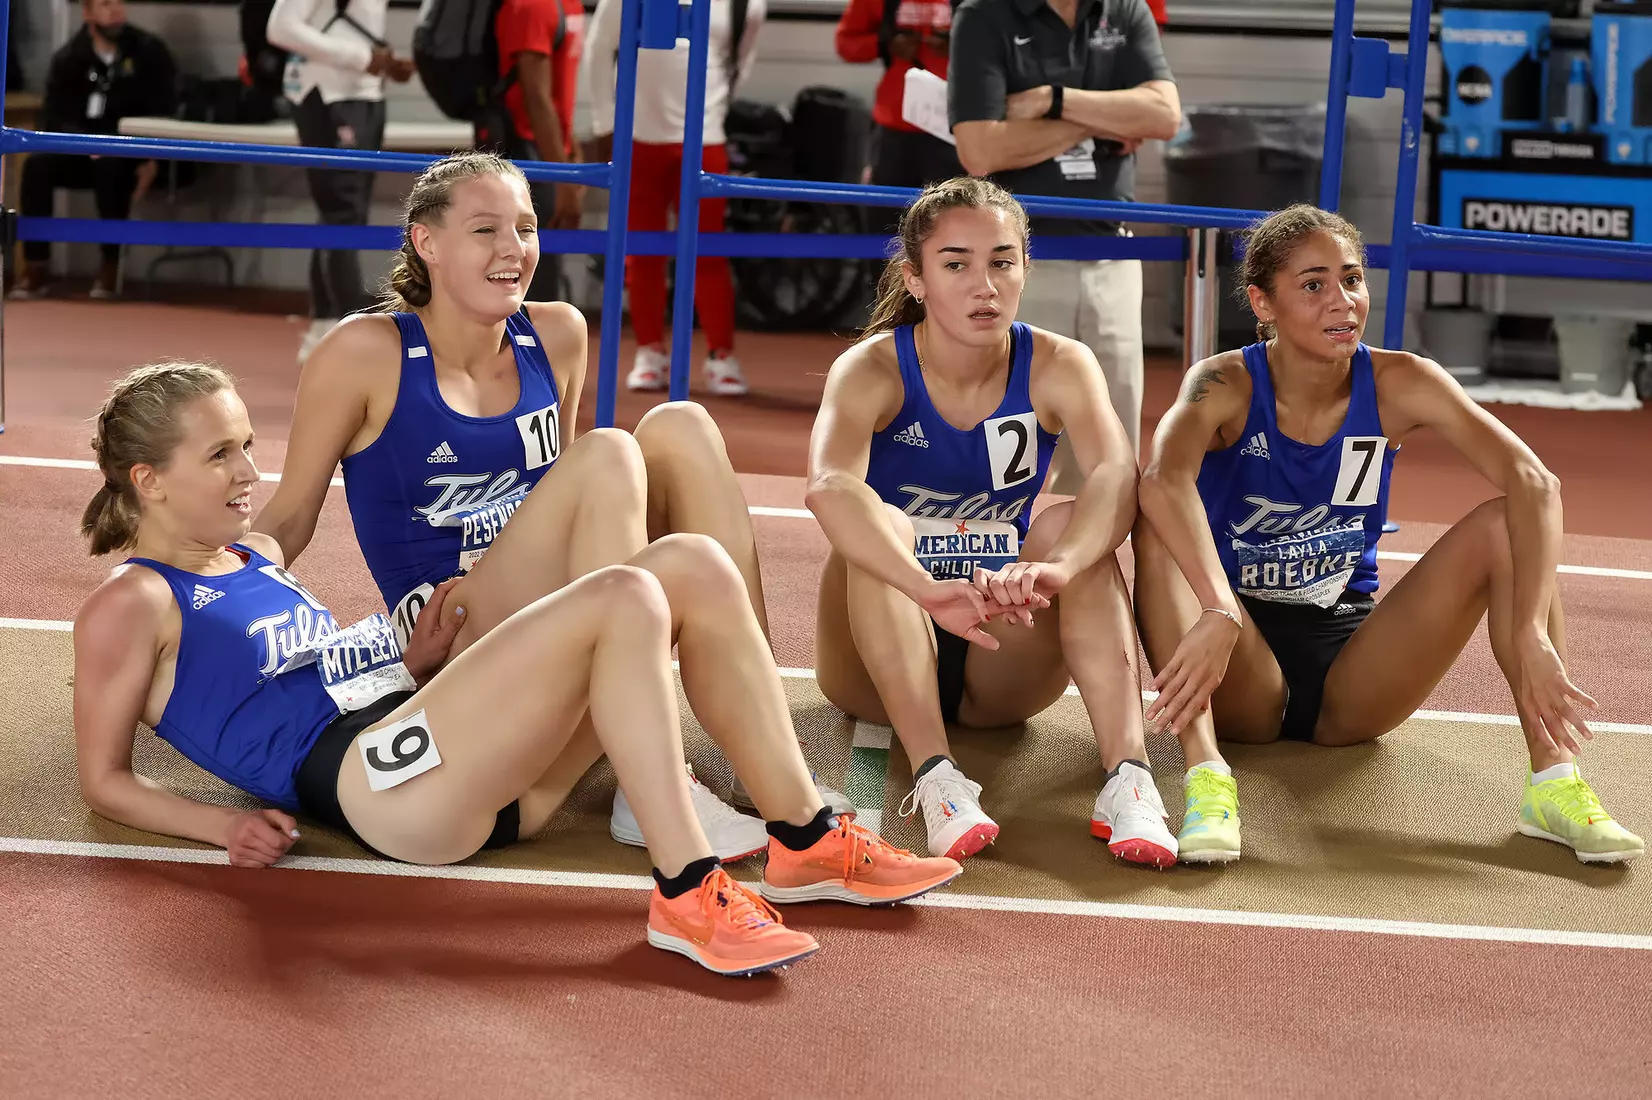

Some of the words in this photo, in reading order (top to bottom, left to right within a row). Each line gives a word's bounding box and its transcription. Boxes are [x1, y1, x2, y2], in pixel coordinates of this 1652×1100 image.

[1464, 202, 1631, 237] POWERADE
[529, 409, 558, 463] 10
[894, 433, 929, 449] adidas
[998, 420, 1030, 484] 2
[1240, 443, 1271, 460] adidas
[426, 454, 458, 464] adidas
[1346, 441, 1377, 502] 7
[414, 468, 532, 516] Tul
[897, 484, 1030, 522] Tulsa
[462, 500, 522, 547] PESEN
[914, 534, 1010, 555] MERICAN
[1278, 540, 1328, 559] LAYLA
[1241, 551, 1361, 587] ROEBKE
[193, 590, 226, 611] adidas
[1334, 607, 1357, 616] adidas
